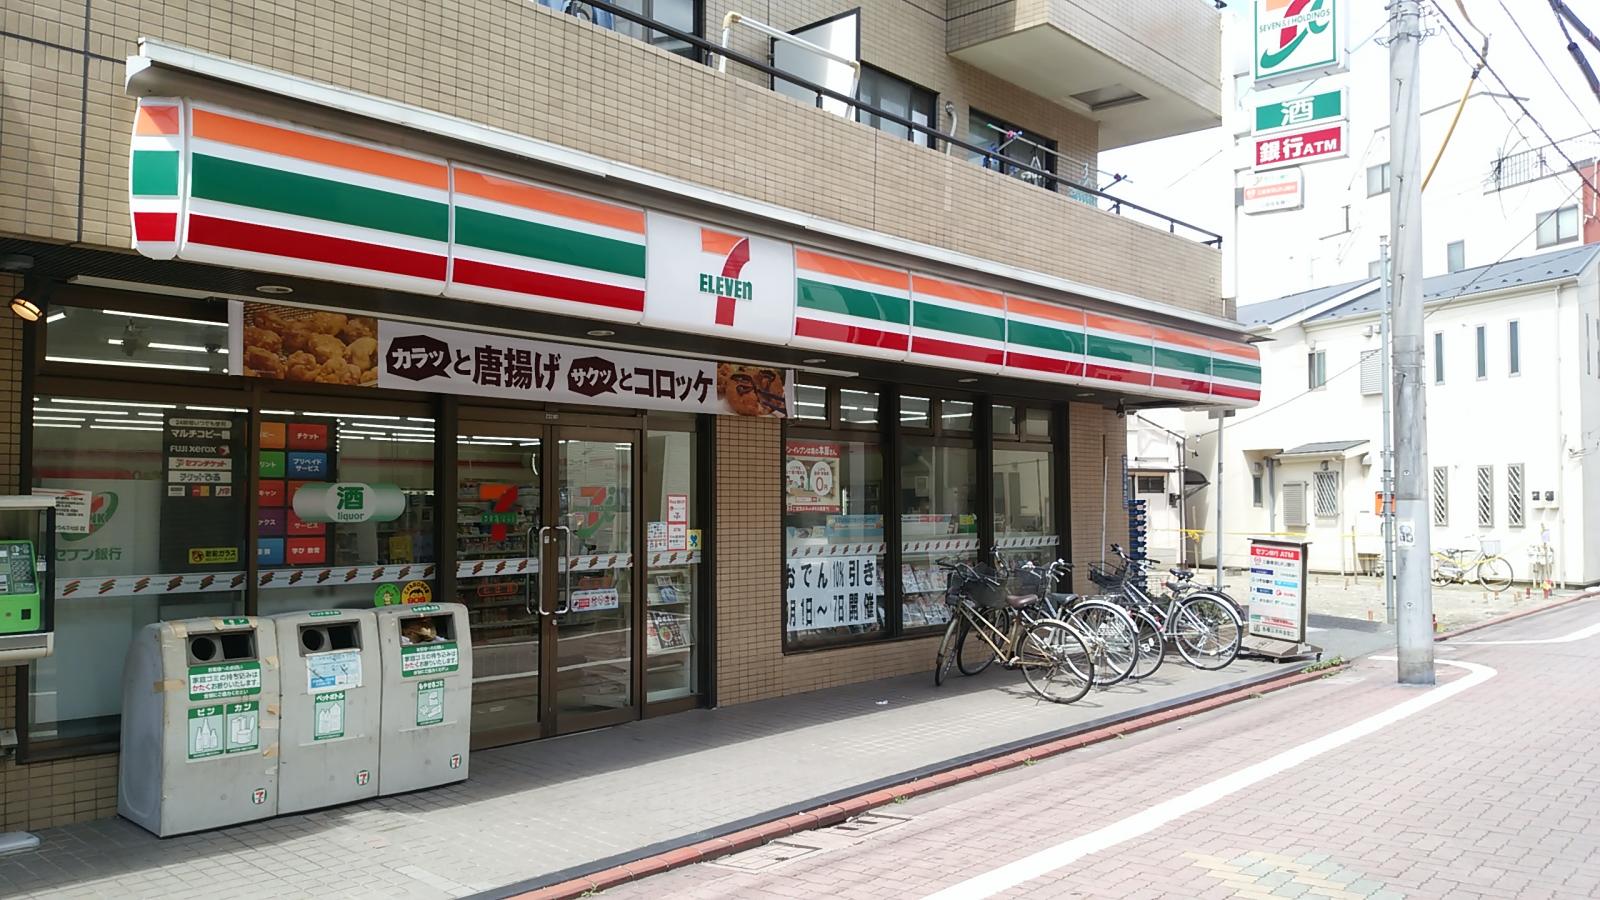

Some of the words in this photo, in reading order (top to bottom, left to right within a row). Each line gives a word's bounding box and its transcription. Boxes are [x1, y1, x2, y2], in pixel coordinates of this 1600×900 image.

[1281, 96, 1315, 127] 酒
[1260, 137, 1337, 163] 銀行ATM
[392, 344, 561, 391] カラッと唐揚げ
[570, 367, 713, 404] サクッとコロッケ
[170, 429, 231, 440] マルチコピー機
[296, 432, 319, 440] チケット
[170, 445, 187, 453] FUJI
[337, 486, 364, 510] 酒
[337, 512, 365, 521] liquor
[192, 672, 258, 684] 家庭ゴミの持ち込みは
[196, 707, 215, 716] ビン
[234, 703, 252, 712] カン
